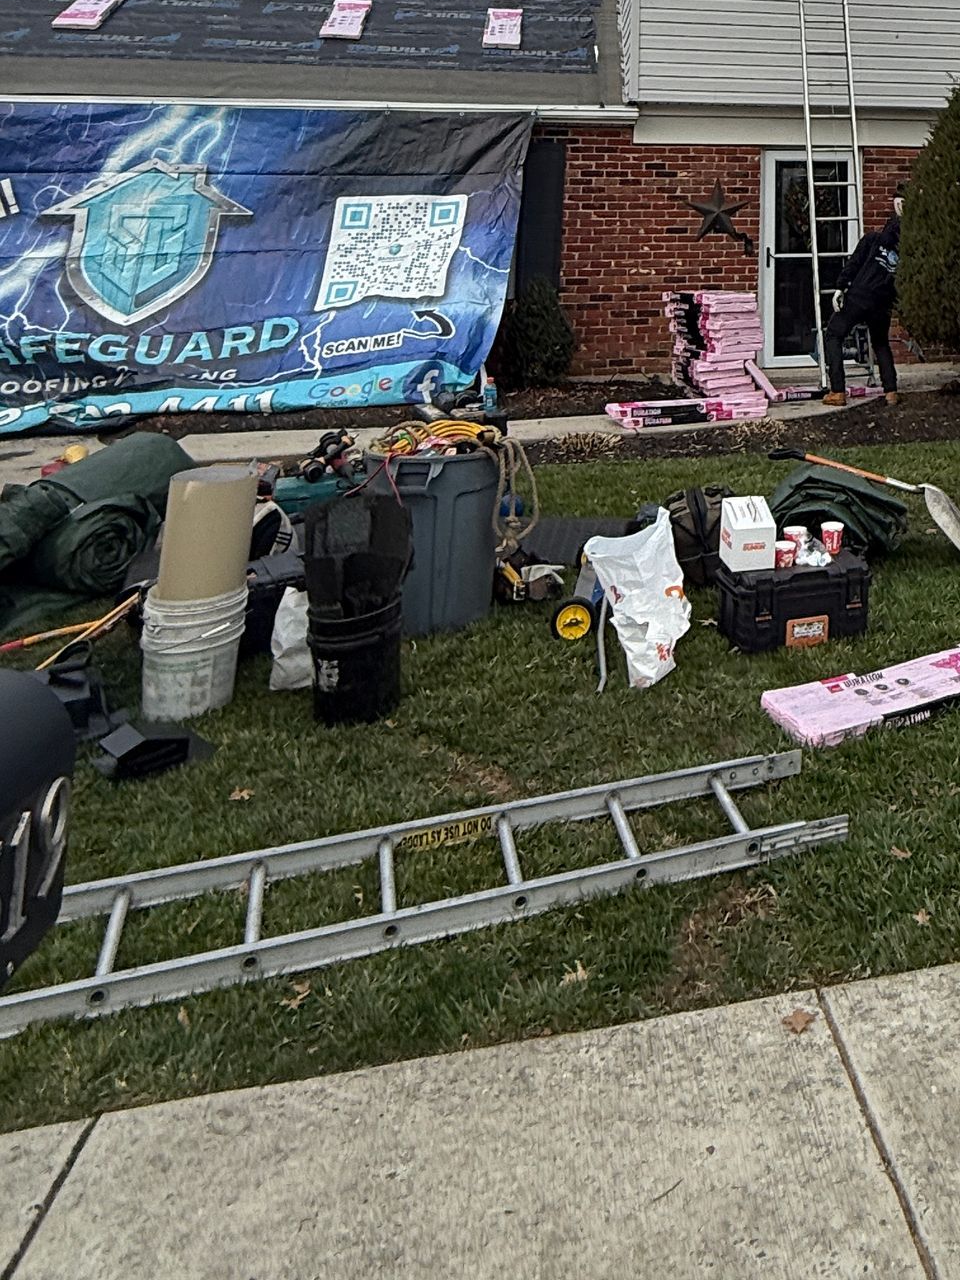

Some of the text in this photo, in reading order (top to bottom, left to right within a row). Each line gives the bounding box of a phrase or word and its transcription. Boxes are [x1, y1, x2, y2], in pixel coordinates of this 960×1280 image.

[0, 316, 299, 366] AFEGUARD
[325, 333, 401, 356] SCAN ME!
[0, 373, 108, 395] OOFING
[308, 372, 393, 402] Google
[444, 824, 460, 840] USE
[462, 819, 478, 836] NOT
[481, 816, 492, 831] DO
[431, 829, 442, 844] AS
